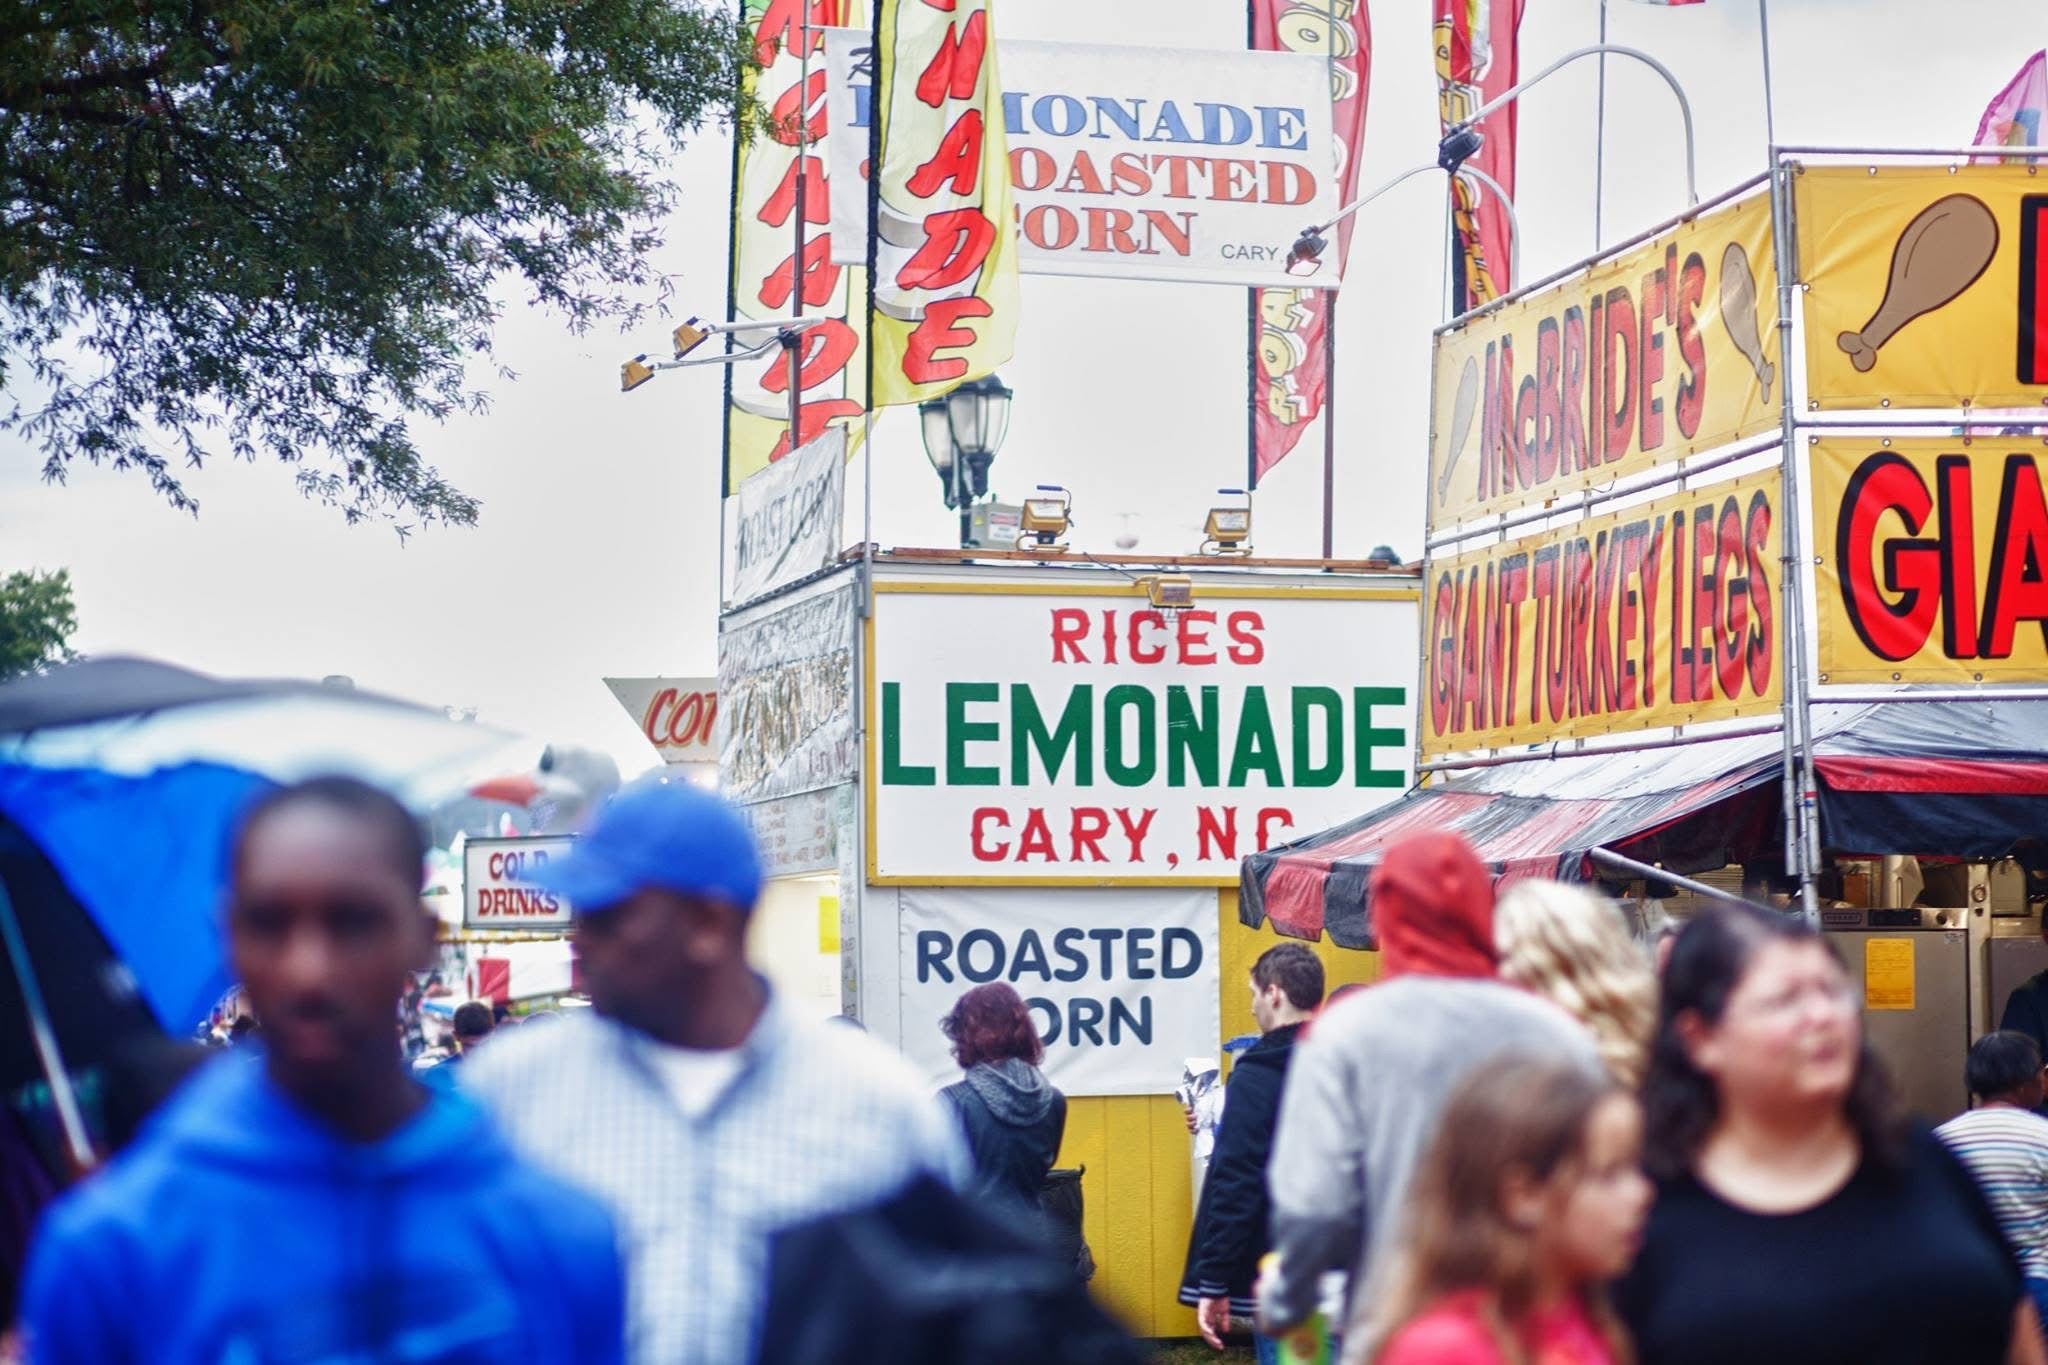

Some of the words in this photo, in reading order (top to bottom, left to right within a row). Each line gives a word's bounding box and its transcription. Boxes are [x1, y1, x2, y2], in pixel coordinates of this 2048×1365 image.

[896, 0, 996, 385] NADE
[1008, 147, 1317, 206] OASTED
[1014, 203, 1198, 257] ORN
[1050, 608, 1265, 665] RICES
[1431, 552, 1528, 738] GIANT
[1531, 515, 1665, 724] TURKEY
[1671, 488, 1774, 705] LEGS
[881, 682, 1407, 788] LEMONADE
[969, 806, 1179, 871] CARY,
[477, 887, 560, 916] DRINKS
[916, 926, 1204, 984] ROASTED
[1026, 995, 1153, 1047] ORN
